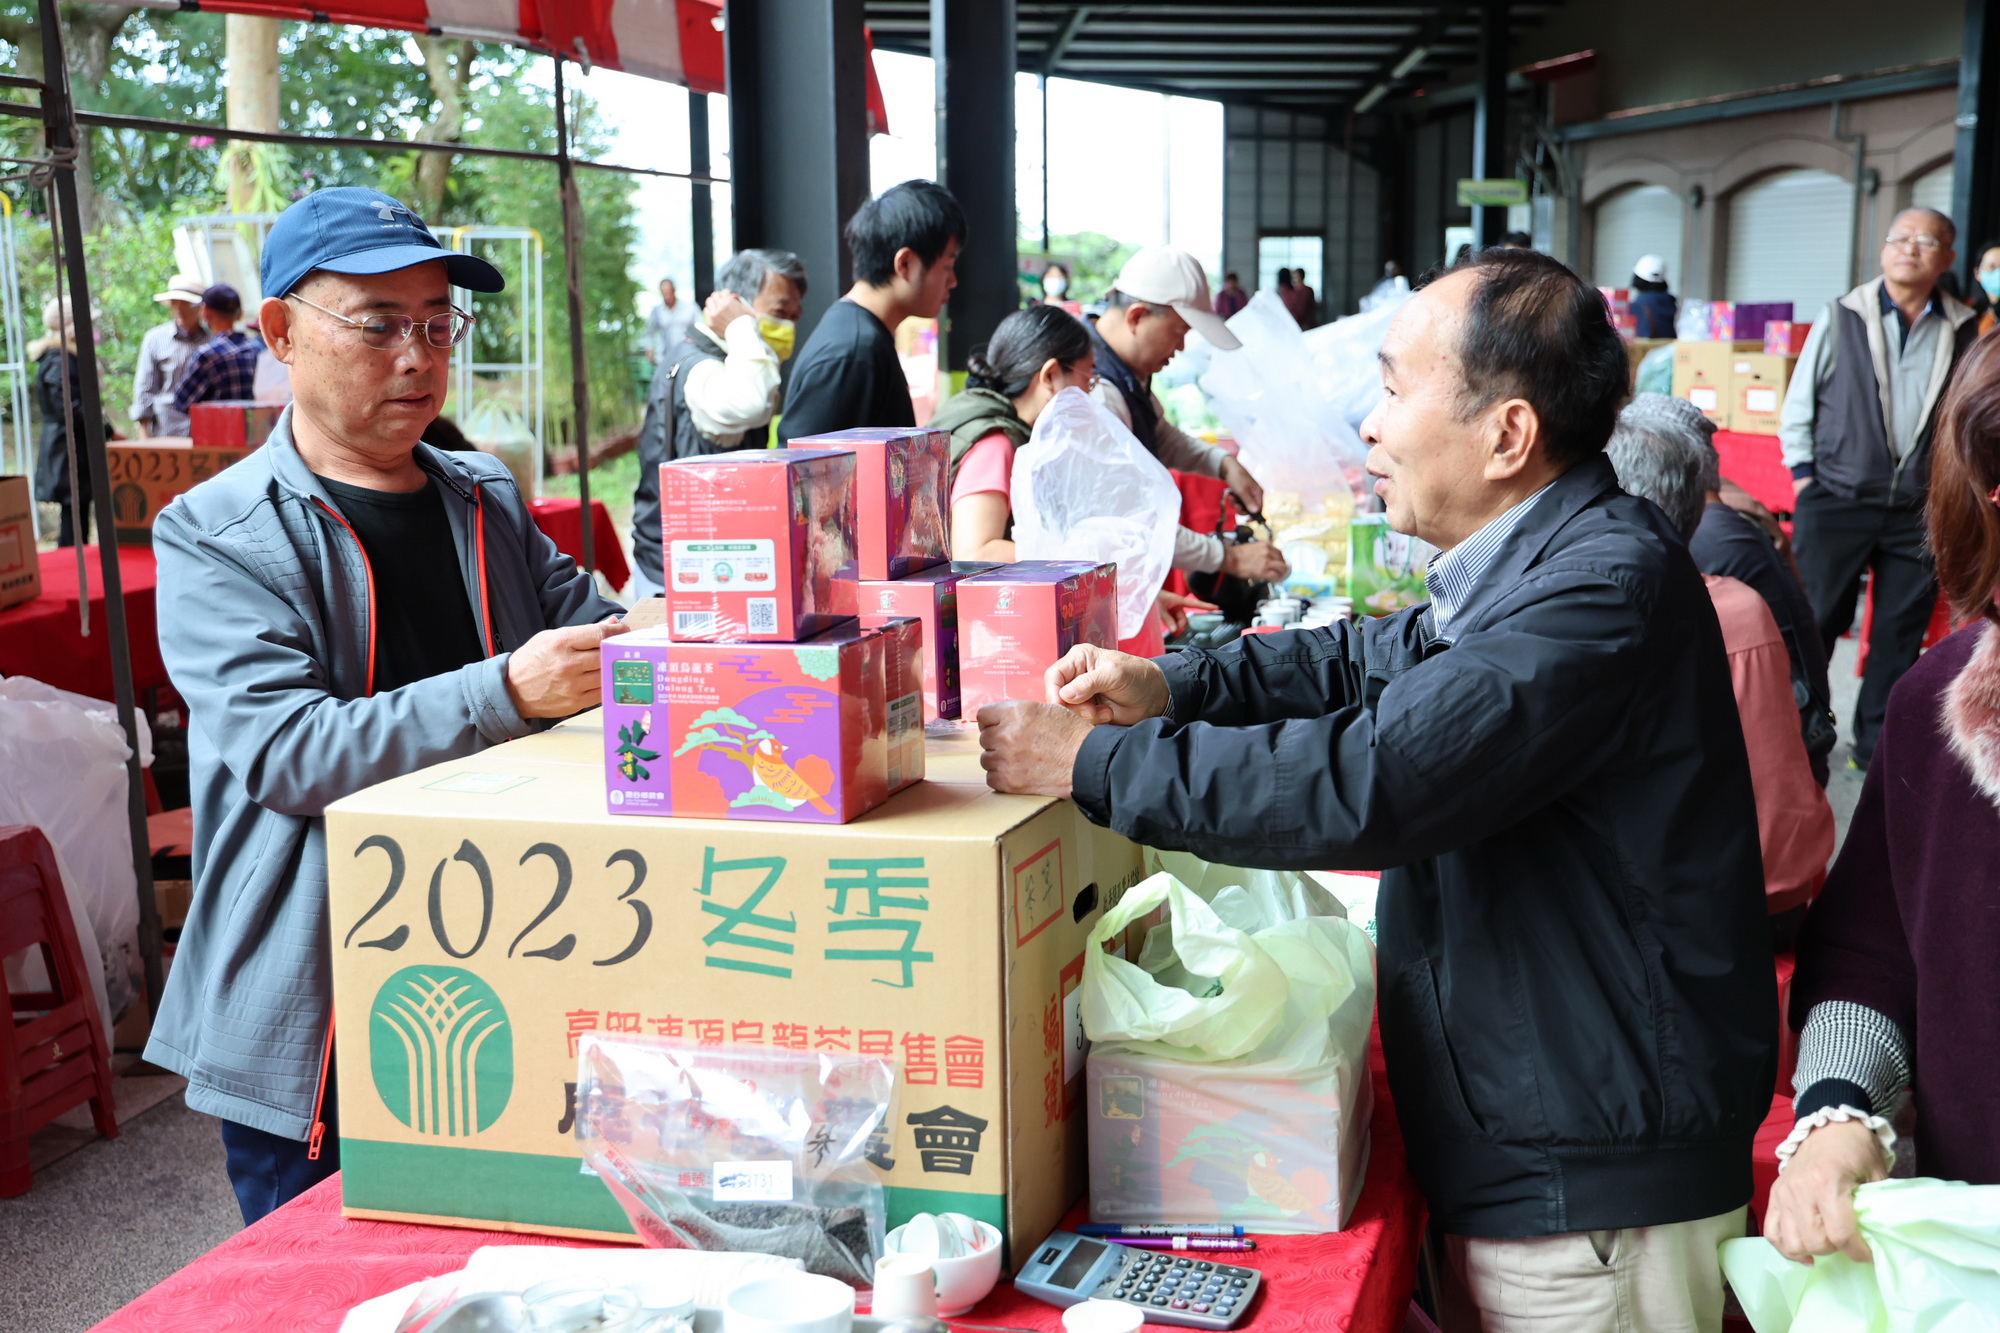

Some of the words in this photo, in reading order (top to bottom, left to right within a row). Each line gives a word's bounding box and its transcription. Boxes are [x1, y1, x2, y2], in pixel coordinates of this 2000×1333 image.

[109, 452, 179, 482] 2023
[657, 674, 705, 684] Dongding
[657, 683, 694, 693] Oolong
[697, 684, 716, 692] Tea
[344, 834, 653, 966] 2023
[692, 846, 934, 988] 冬季
